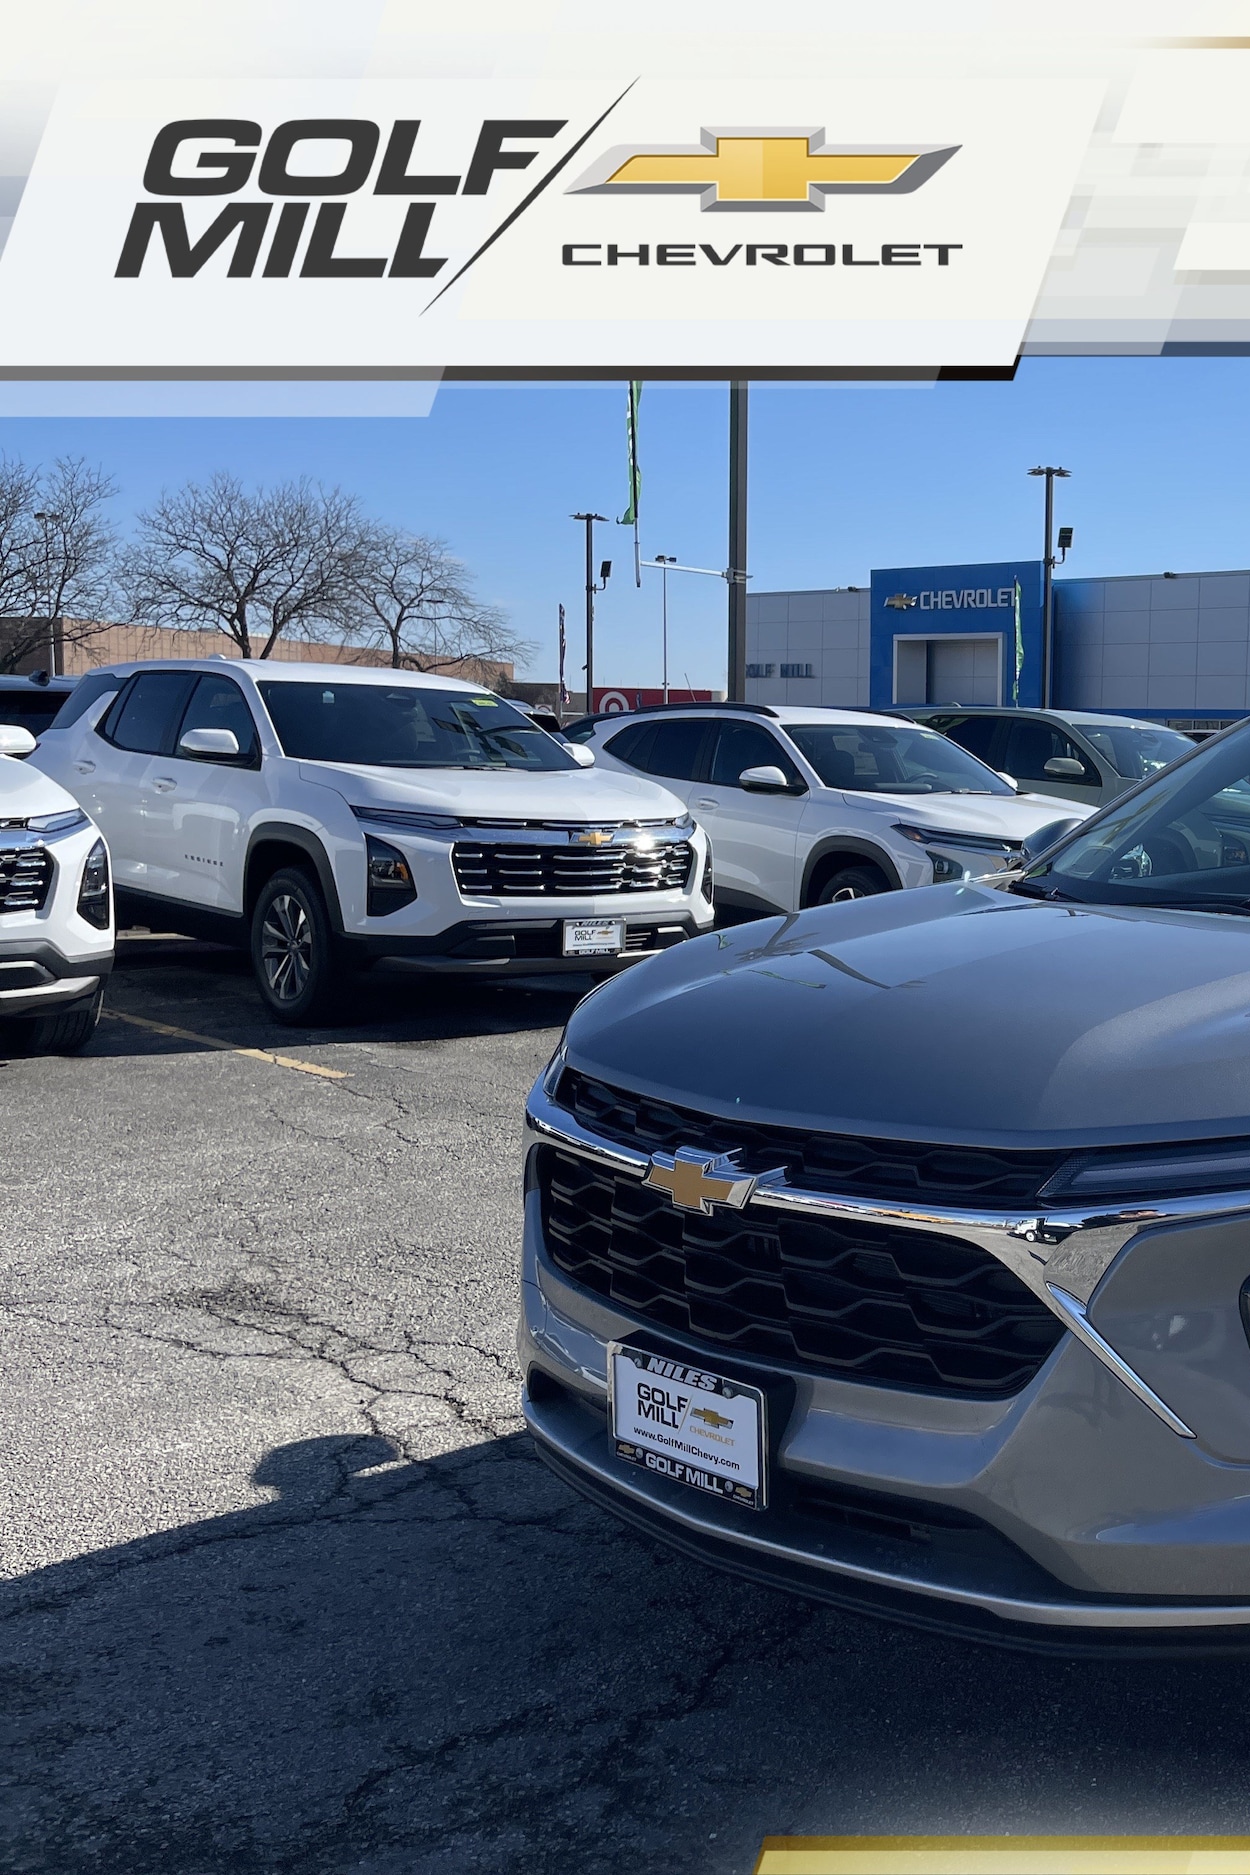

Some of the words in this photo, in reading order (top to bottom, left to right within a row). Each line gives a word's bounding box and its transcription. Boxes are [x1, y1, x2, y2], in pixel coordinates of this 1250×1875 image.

[920, 587, 1015, 610] CHEVROLET
[646, 1357, 717, 1391] NILES
[637, 1382, 688, 1412] GOLF
[637, 1399, 679, 1429] MILL
[633, 1426, 740, 1470] www.GolfMillChevy.com
[689, 1425, 735, 1446] CHEVROLET
[645, 1452, 684, 1479] GOLF
[685, 1467, 723, 1494] MILL
